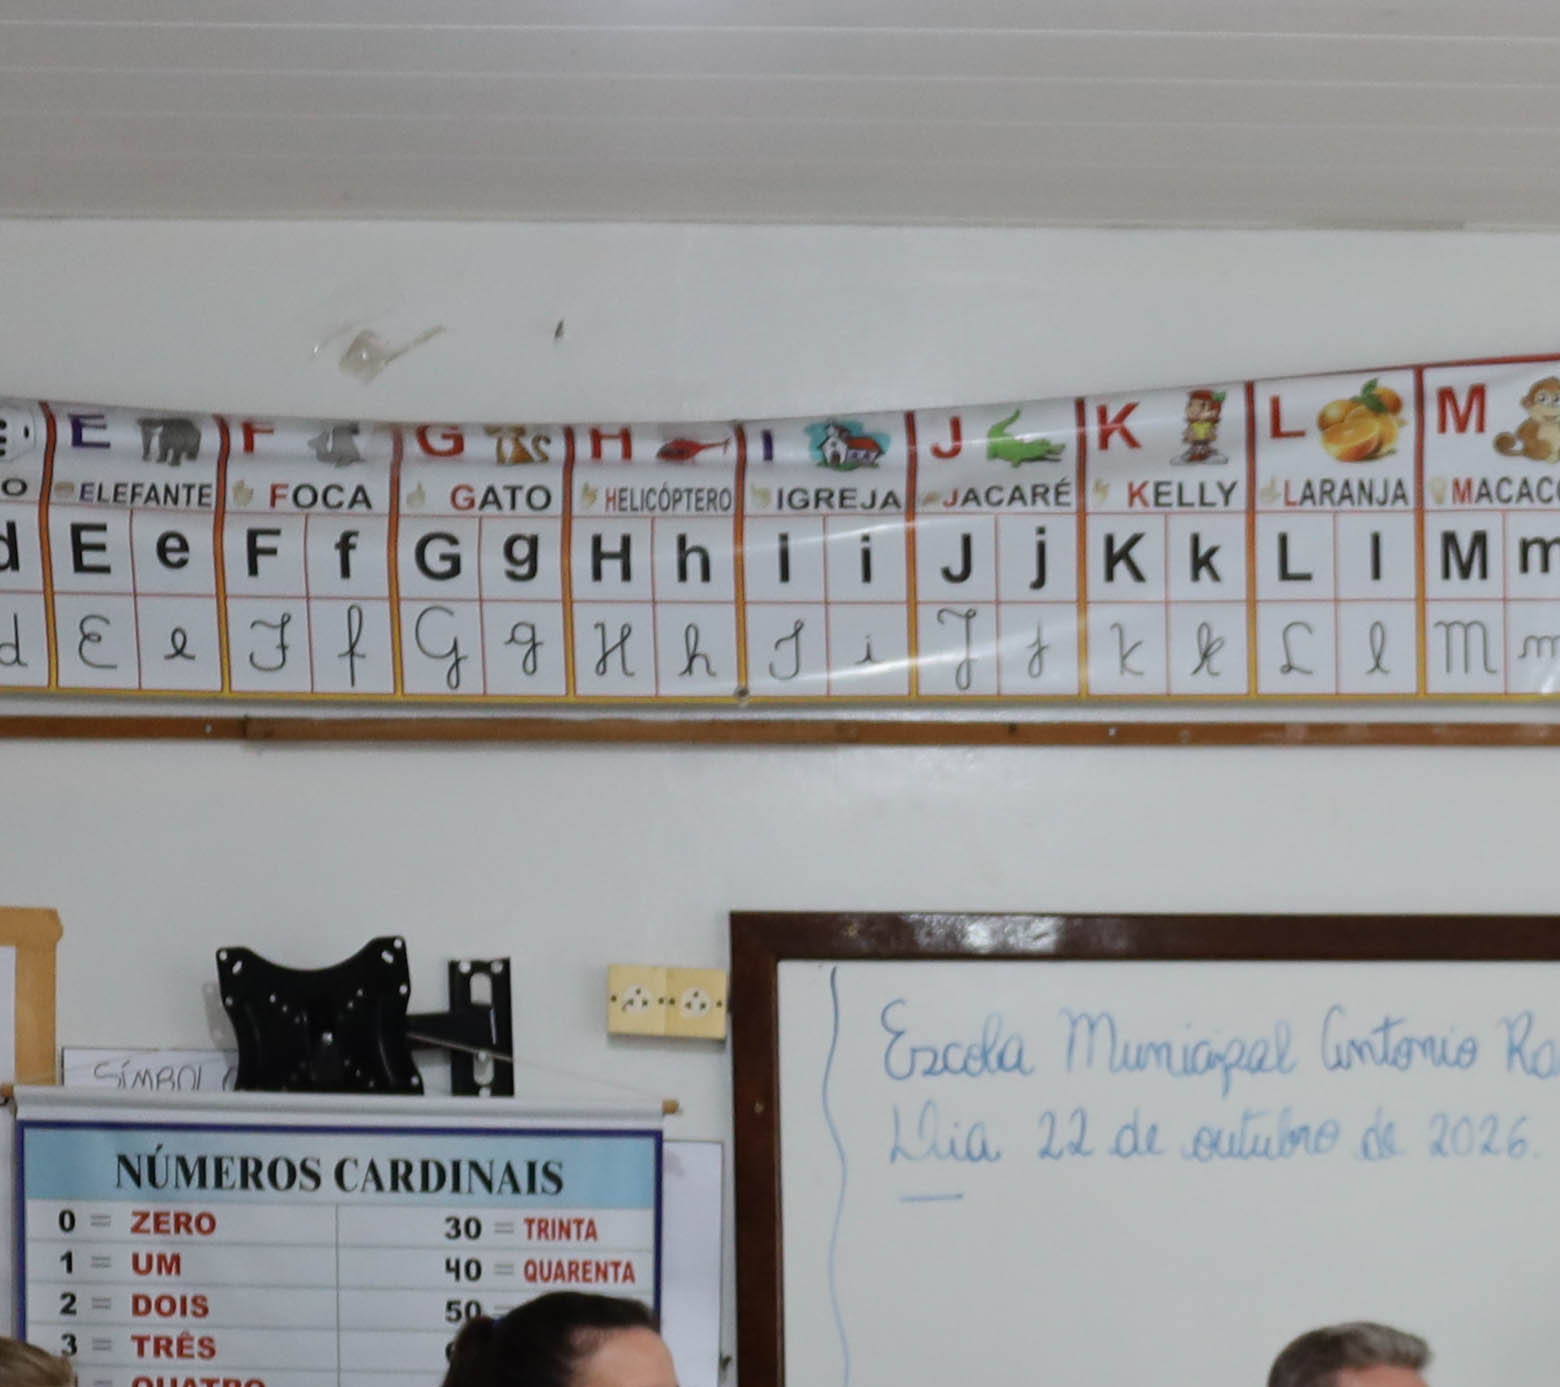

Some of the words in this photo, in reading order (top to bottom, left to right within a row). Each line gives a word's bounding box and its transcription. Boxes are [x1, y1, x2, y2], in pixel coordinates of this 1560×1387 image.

[79, 482, 212, 508] ELEFANTE
[269, 482, 373, 510] FOCA
[450, 484, 552, 511] GATO
[605, 482, 732, 513] HELICÓPTERO
[777, 486, 902, 510] IGREJA
[943, 477, 1072, 508] JACARÉ
[1128, 480, 1238, 508] KELLY
[1283, 477, 1409, 508] LARANJA
[881, 998, 1036, 1081] Escola
[1060, 1006, 1297, 1099] Municipal
[1038, 1106, 1093, 1160] 22
[1109, 1108, 1164, 1160] de
[1181, 1106, 1340, 1162] outubro
[1353, 1108, 1401, 1161] de
[116, 1145, 321, 1193] NÚMEROS
[335, 1157, 564, 1196] CARDINAIS
[58, 1210, 75, 1233] 0
[130, 1211, 217, 1236] ZERO
[444, 1217, 482, 1240] 30
[524, 1217, 598, 1242] TRINTA
[61, 1252, 75, 1275] 1
[131, 1252, 181, 1277] UM
[445, 1259, 482, 1282] 40
[524, 1259, 635, 1284] QUARENTA
[60, 1294, 77, 1316] 2
[131, 1295, 209, 1318] DOIS
[445, 1300, 482, 1322] 50
[61, 1335, 77, 1357] 3
[131, 1334, 217, 1360] TRÊS
